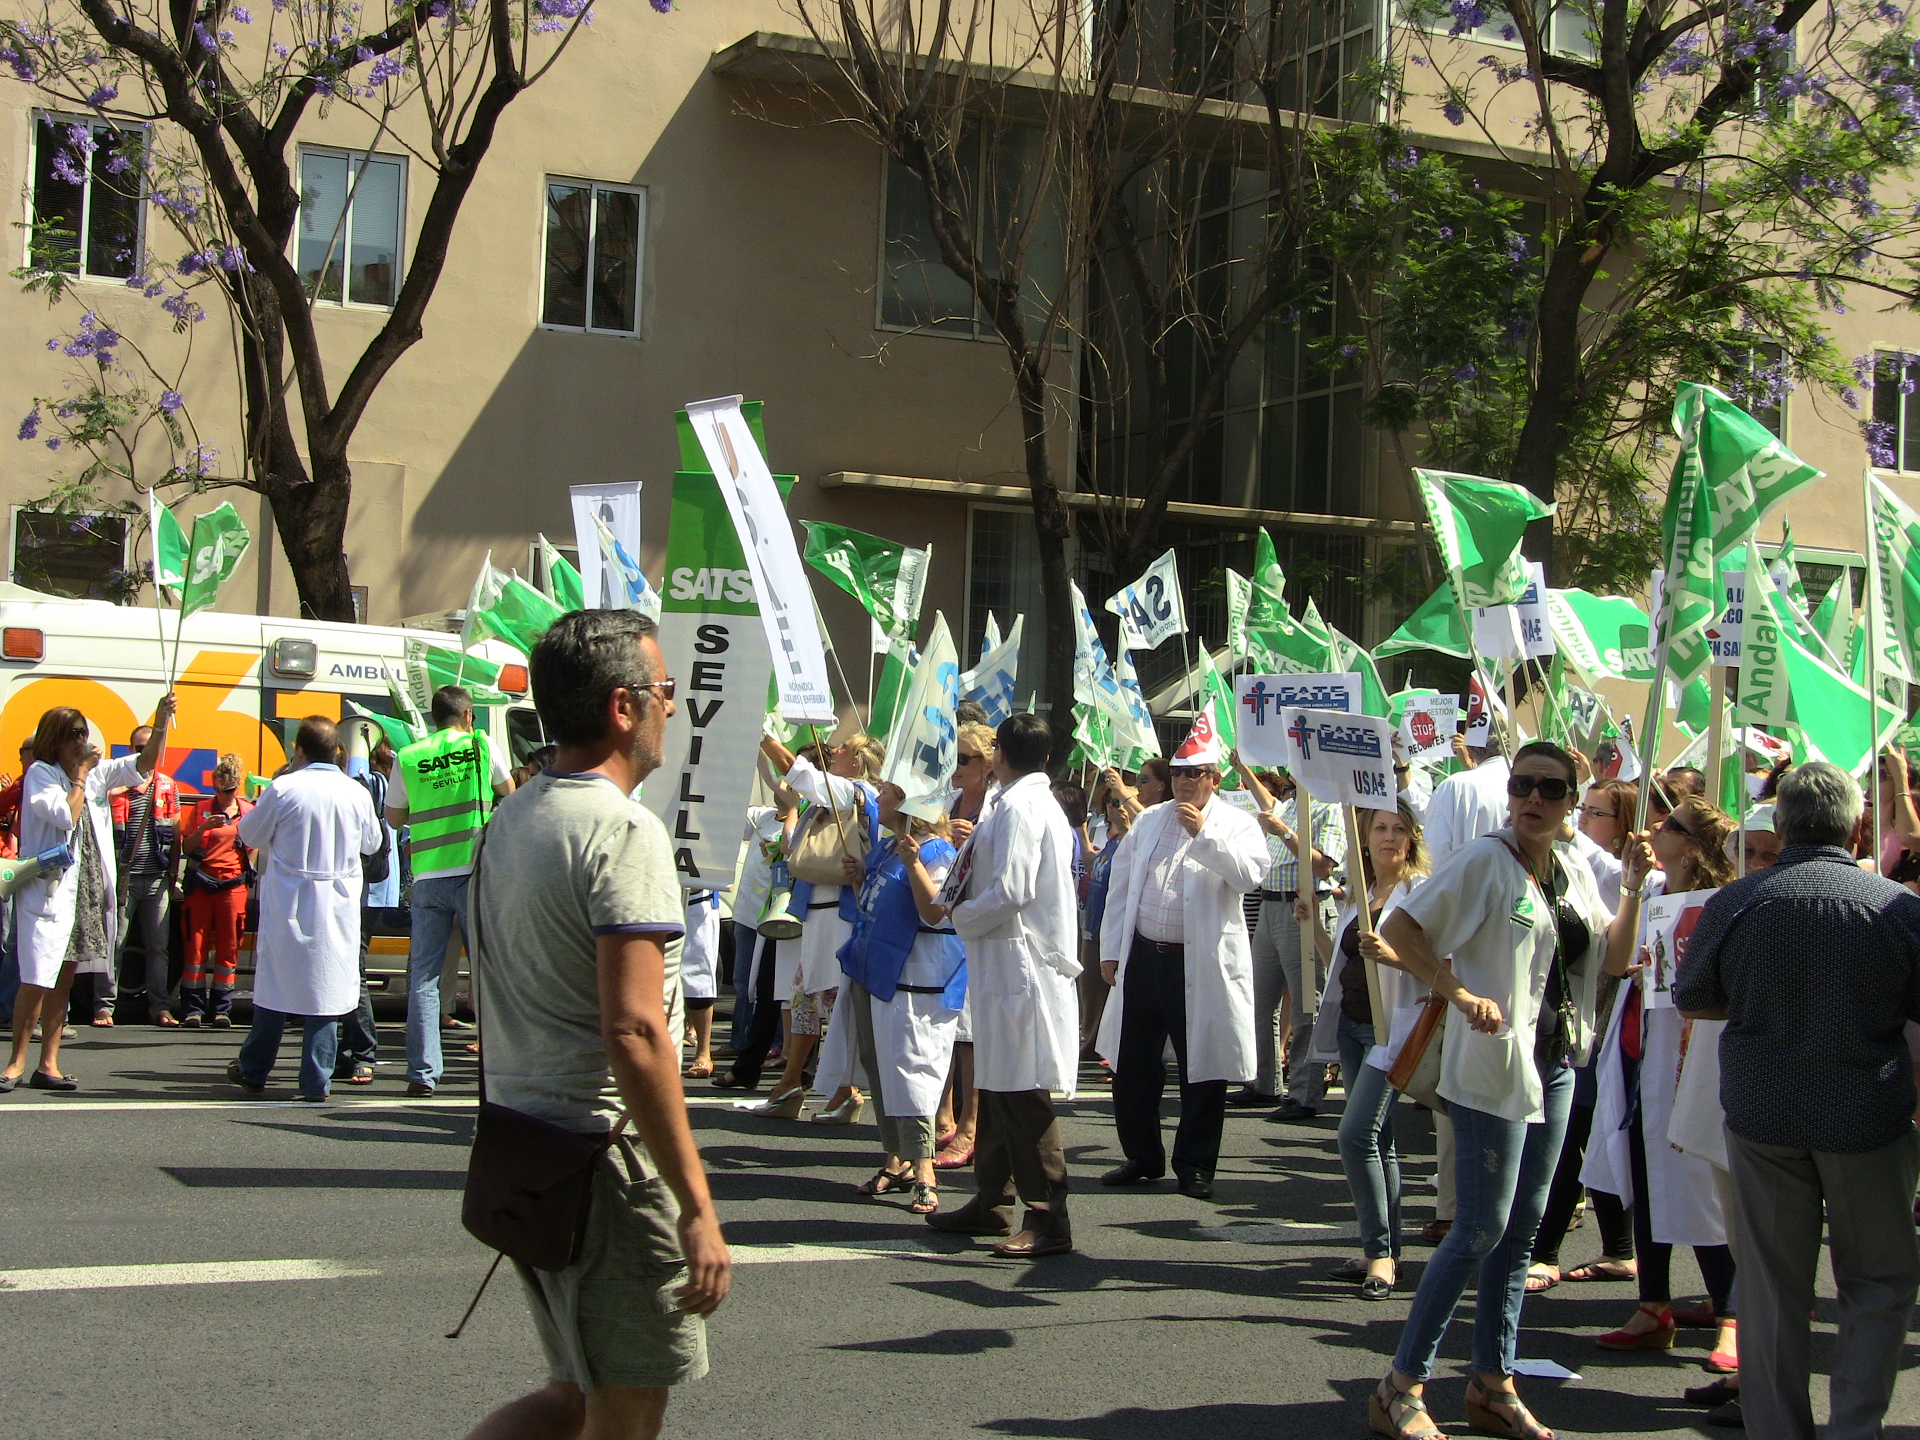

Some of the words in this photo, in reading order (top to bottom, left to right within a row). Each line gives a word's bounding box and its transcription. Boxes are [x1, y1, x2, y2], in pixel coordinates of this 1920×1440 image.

[1281, 686, 1346, 701] FATE
[1430, 698, 1453, 706] MEJOR
[1320, 724, 1378, 744] FATE
[1412, 724, 1433, 736] STOP
[675, 624, 730, 878] SEVILLA
[418, 749, 475, 774] SATSE
[433, 774, 470, 790] SEVILLA
